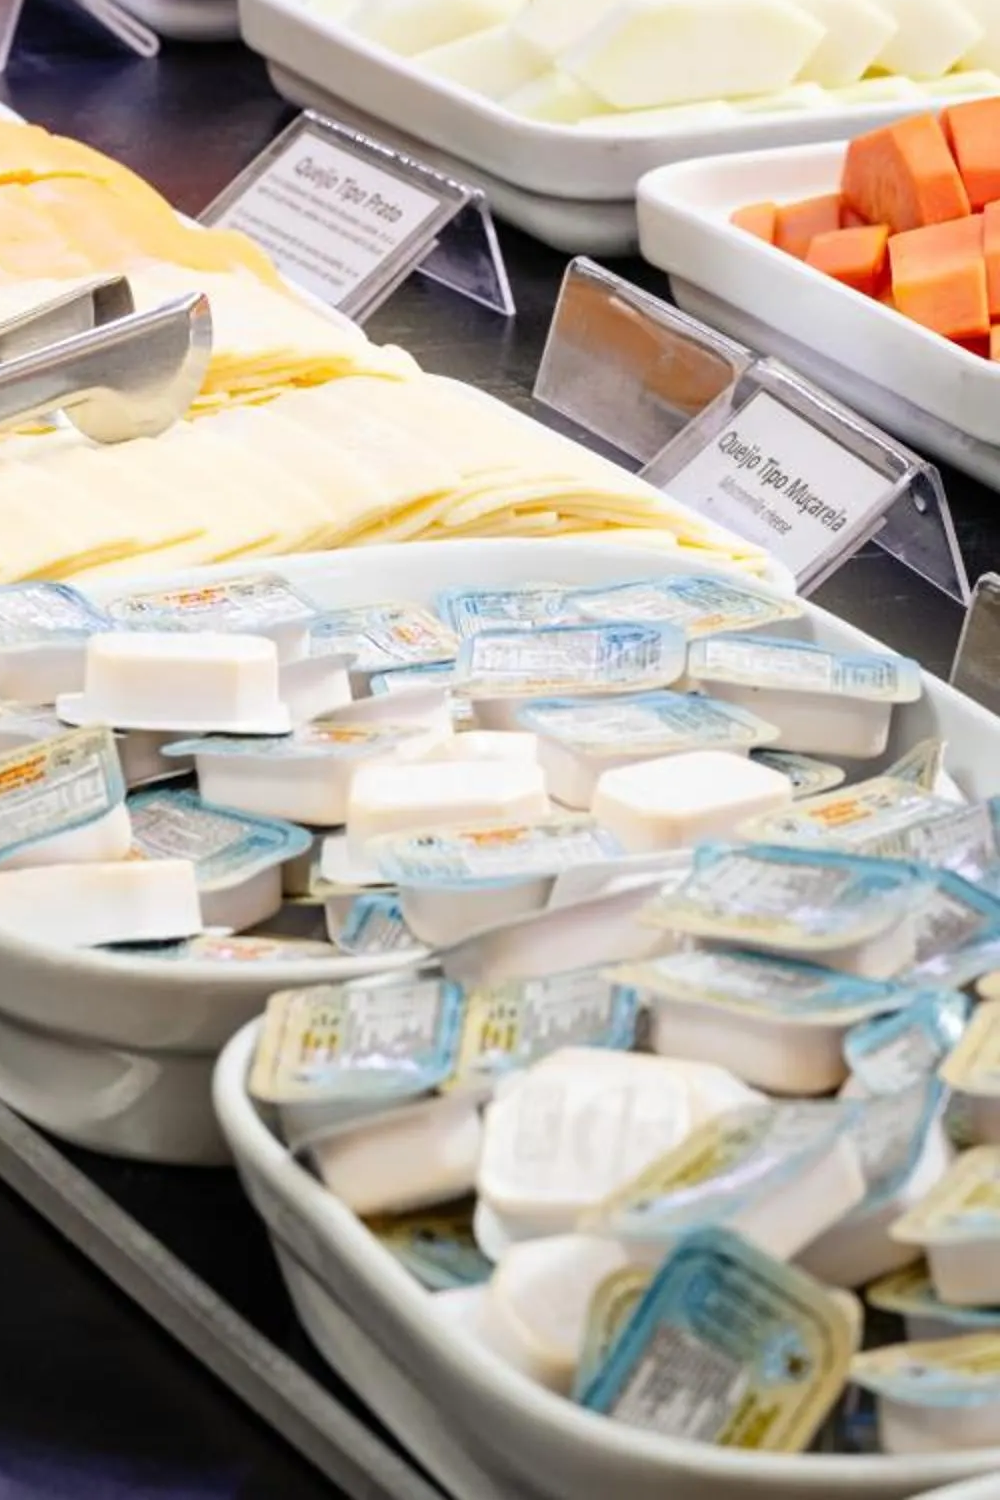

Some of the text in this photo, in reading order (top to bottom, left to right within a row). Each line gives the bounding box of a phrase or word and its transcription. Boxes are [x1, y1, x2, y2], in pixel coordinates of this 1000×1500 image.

[718, 431, 761, 468] Queijo
[757, 457, 789, 489] Tipo
[783, 478, 847, 532] Muçarela
